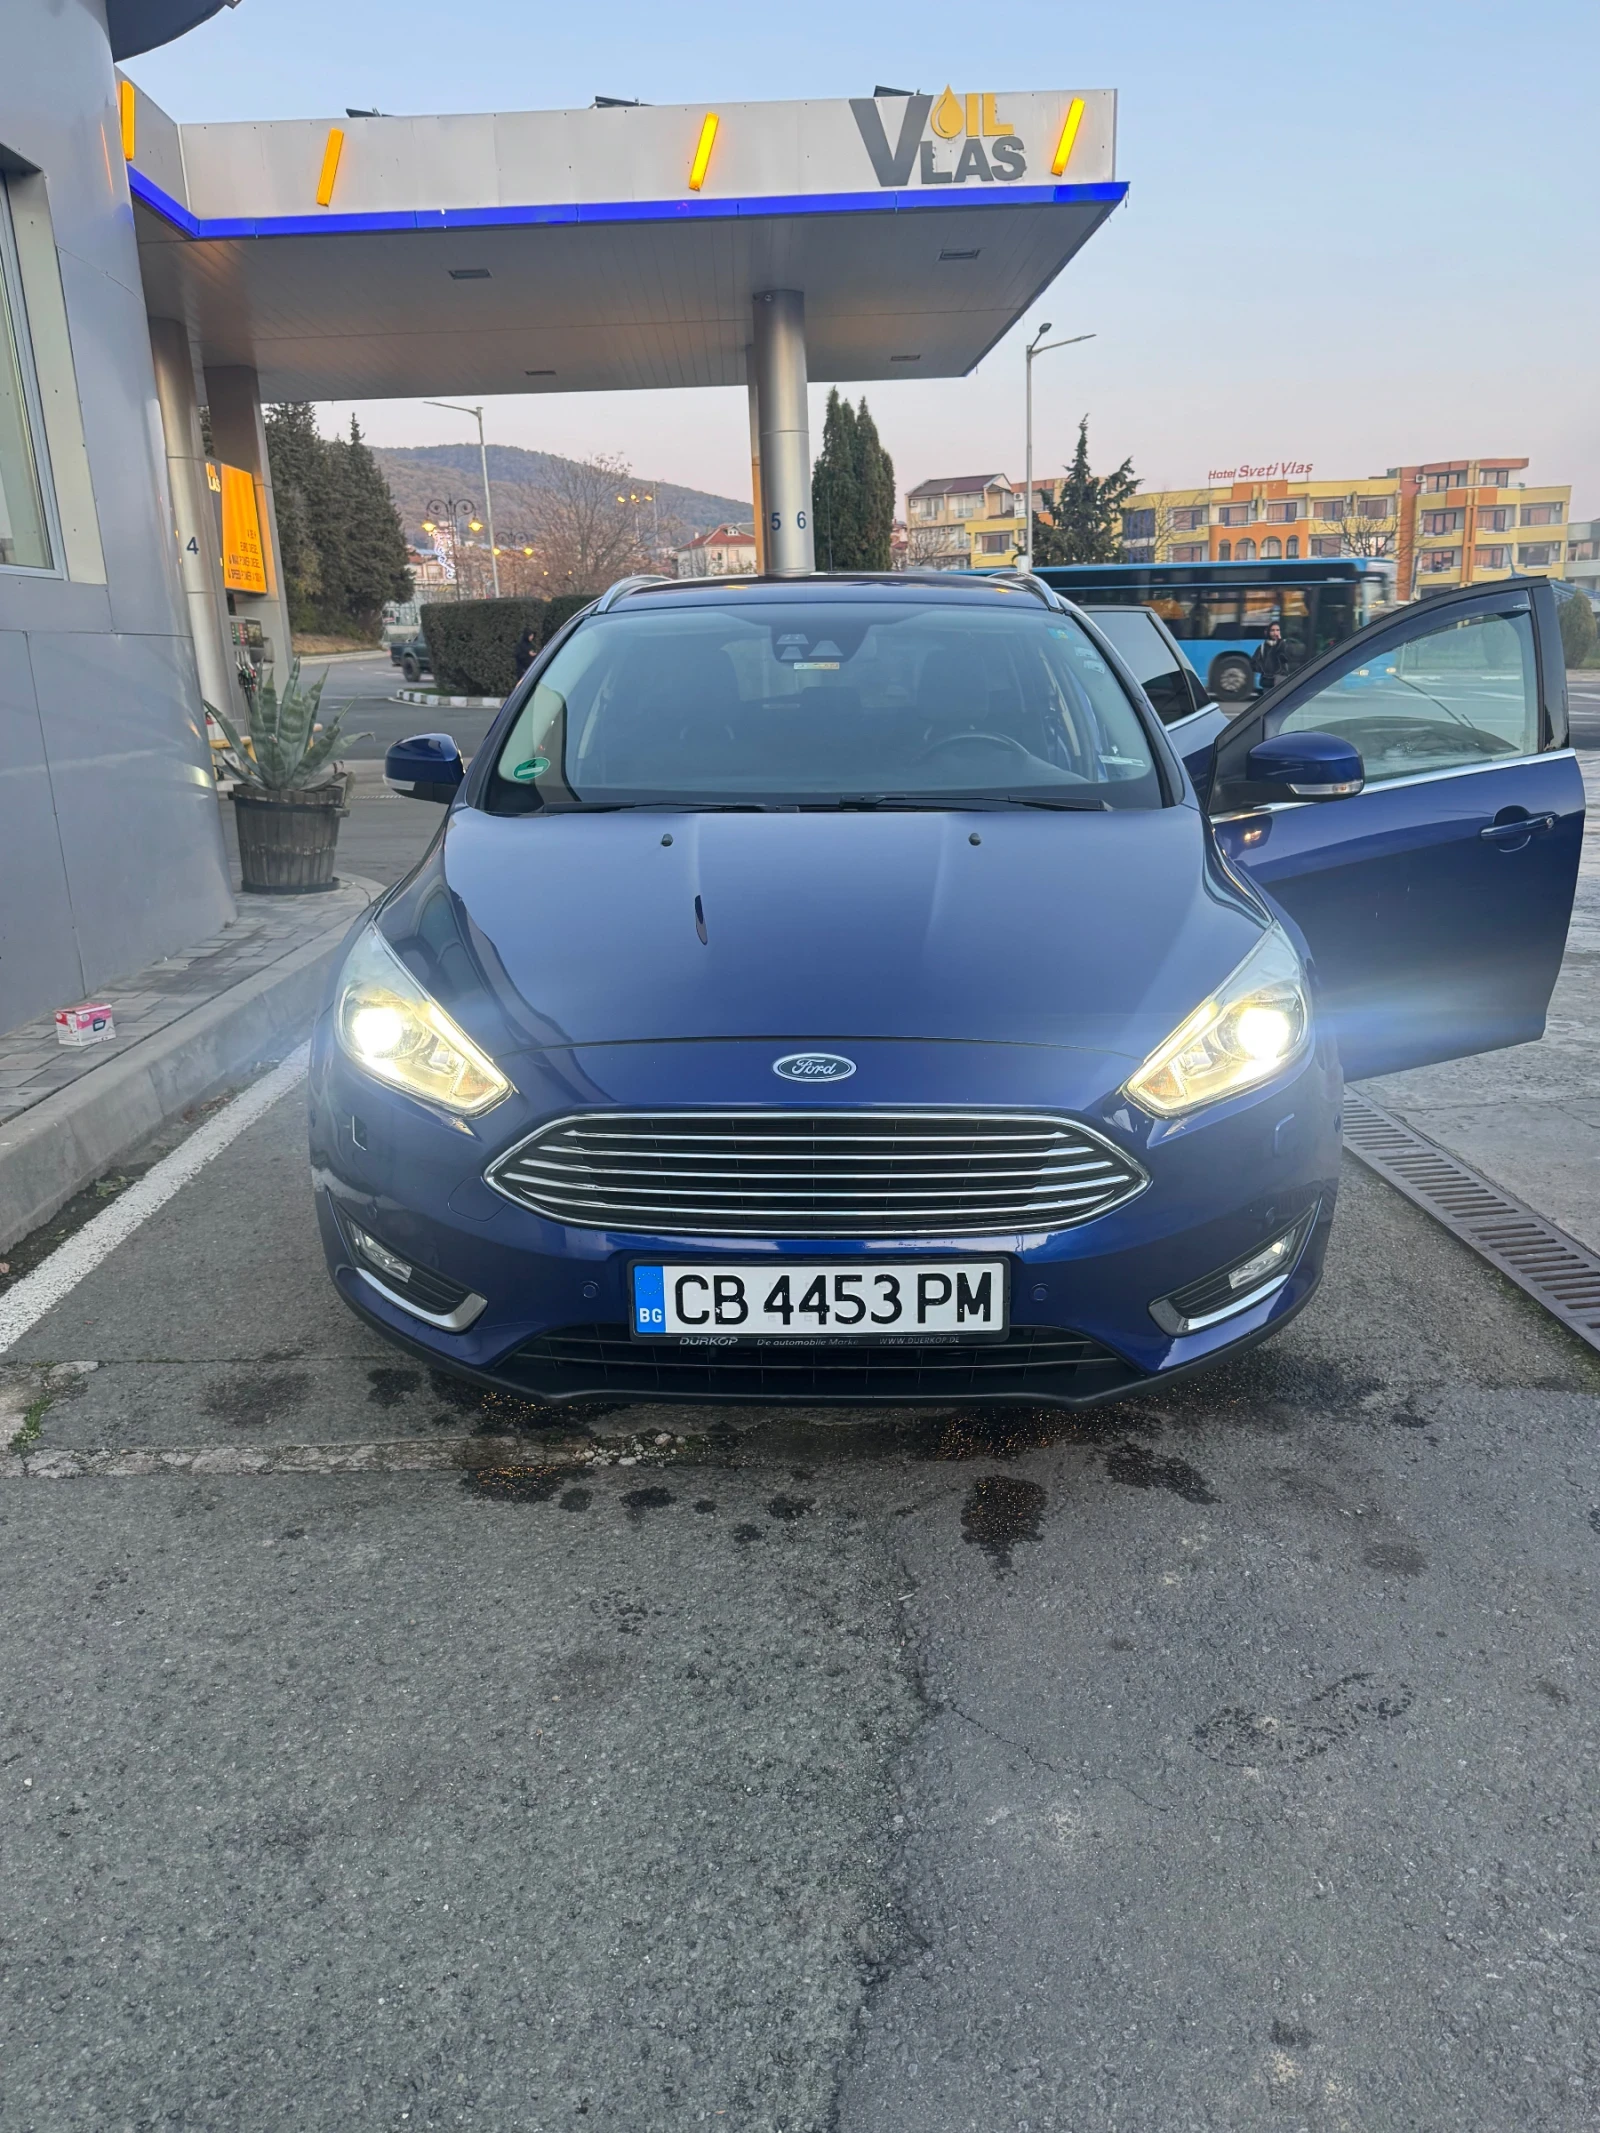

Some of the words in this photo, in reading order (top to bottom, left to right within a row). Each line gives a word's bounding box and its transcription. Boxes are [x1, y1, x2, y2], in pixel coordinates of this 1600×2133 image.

[1208, 469, 1236, 479] Hotel
[1239, 462, 1279, 478] Sveti
[1281, 461, 1313, 475] Vlas
[771, 512, 781, 531] 5
[796, 511, 807, 529] 6
[186, 536, 199, 555] 4
[791, 1058, 837, 1075] Ford
[674, 1273, 749, 1326] CB
[763, 1273, 903, 1326] 4453
[917, 1271, 993, 1324] PM
[639, 1308, 663, 1324] BG
